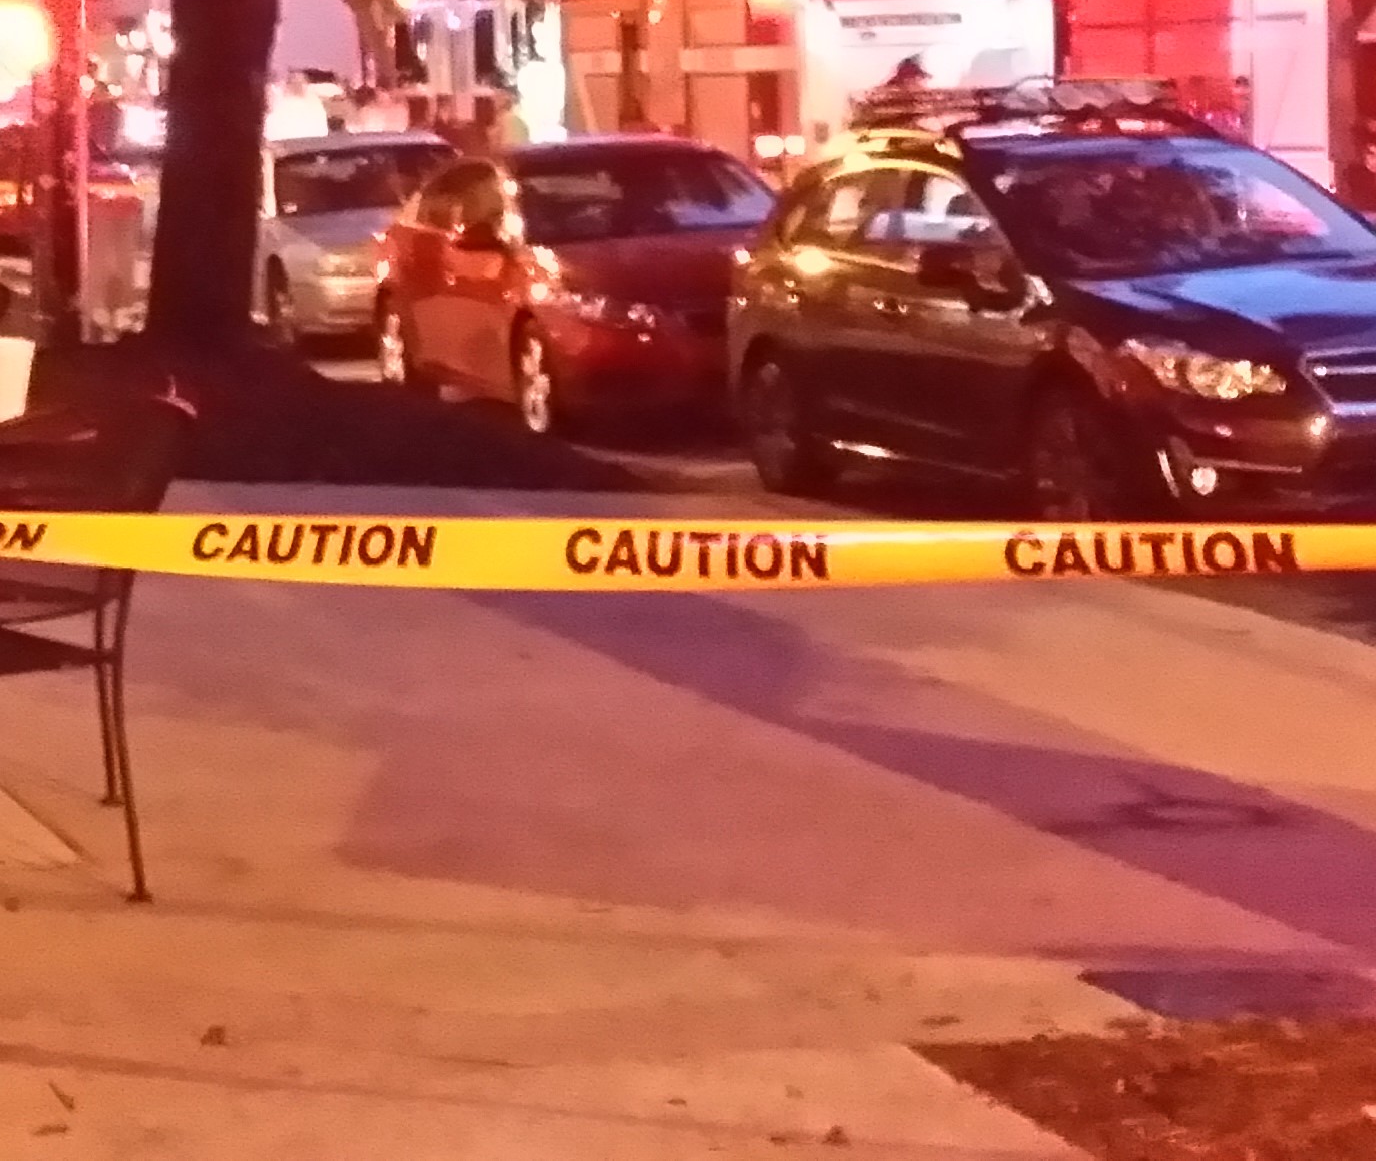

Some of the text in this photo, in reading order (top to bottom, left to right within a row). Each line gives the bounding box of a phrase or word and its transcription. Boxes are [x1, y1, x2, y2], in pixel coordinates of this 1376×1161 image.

[191, 521, 437, 570] CAUTION
[564, 527, 830, 581] CAUTION
[1004, 529, 1302, 576] CAUTION
